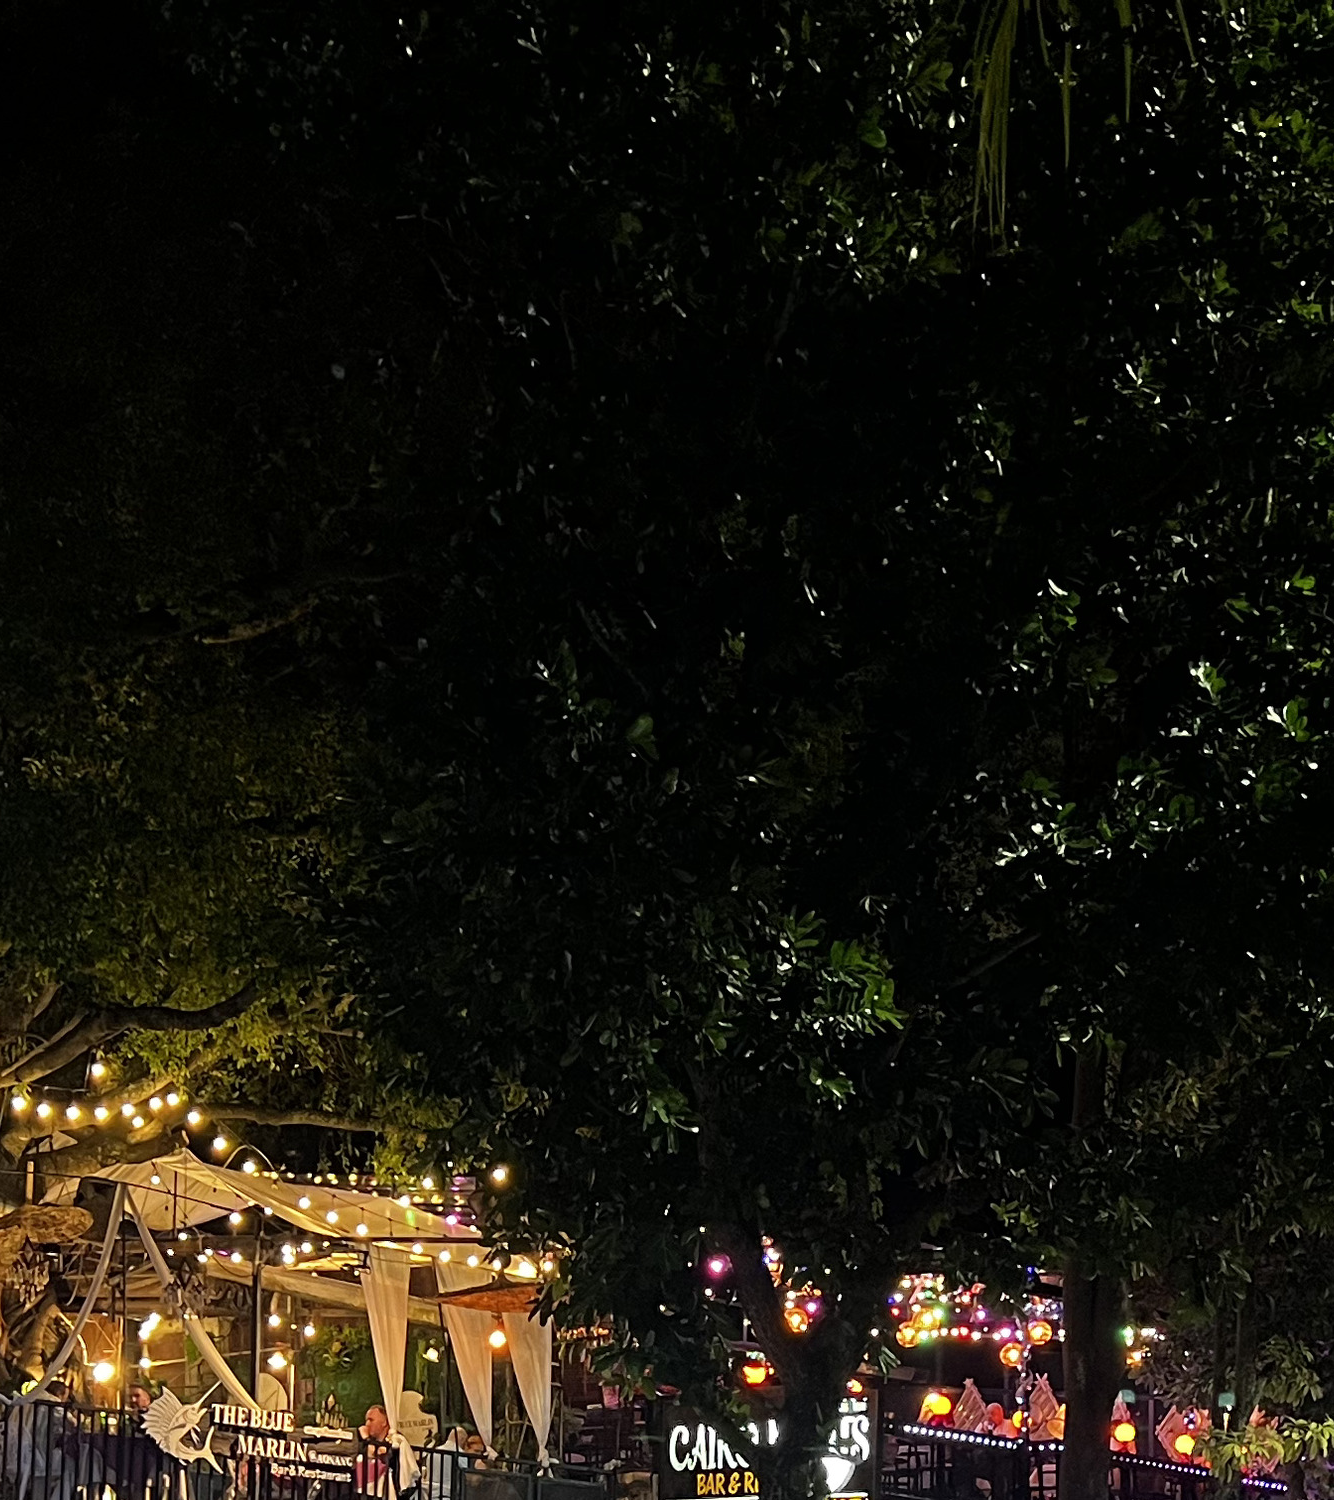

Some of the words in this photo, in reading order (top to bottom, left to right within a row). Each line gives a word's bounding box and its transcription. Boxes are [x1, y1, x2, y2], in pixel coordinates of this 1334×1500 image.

[211, 1403, 249, 1427] THE
[251, 1408, 295, 1432] BLUE
[237, 1434, 309, 1462] MARLIN
[697, 1473, 725, 1496] BAR
[728, 1471, 742, 1495] &
